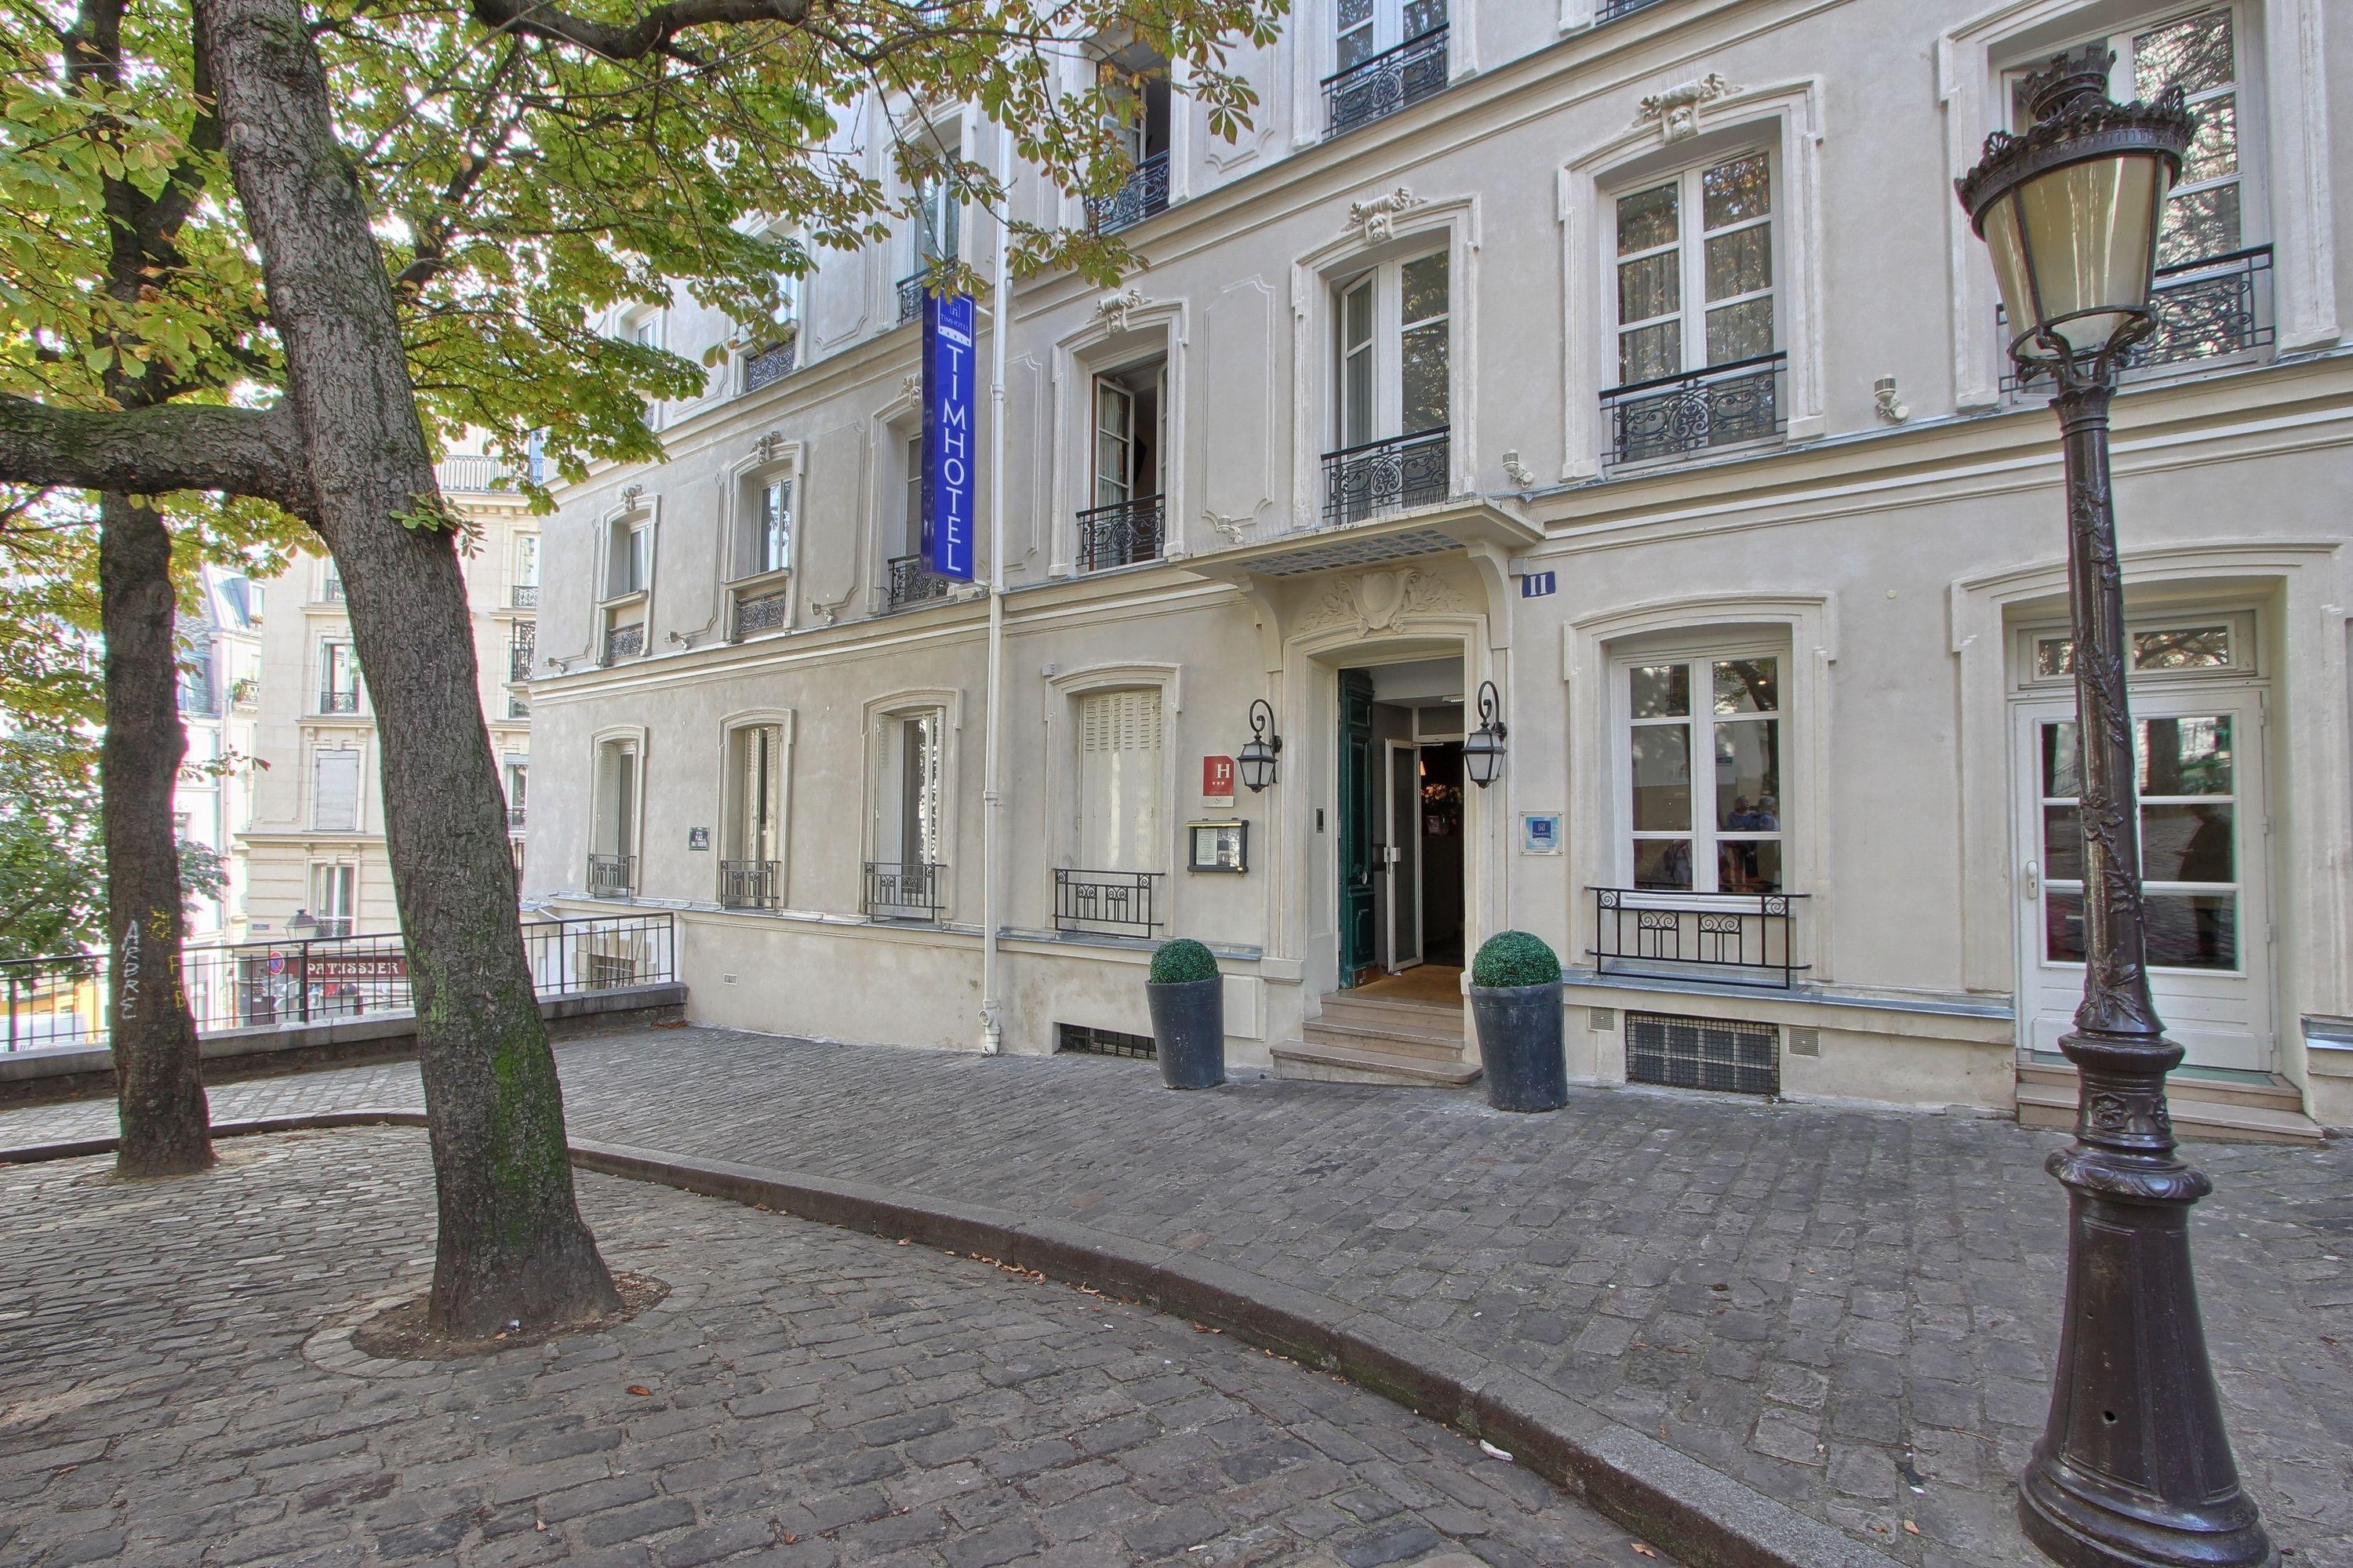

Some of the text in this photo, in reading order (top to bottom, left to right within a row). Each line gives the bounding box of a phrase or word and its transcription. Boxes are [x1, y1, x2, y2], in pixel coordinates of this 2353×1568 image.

[940, 313, 969, 332] TIMHOTEL
[940, 328, 970, 345] PARIS
[943, 344, 967, 572] TIMHOTEL
[1217, 763, 1231, 779] H
[120, 919, 140, 1020] ARBRE
[307, 962, 399, 975] PATISSIER
